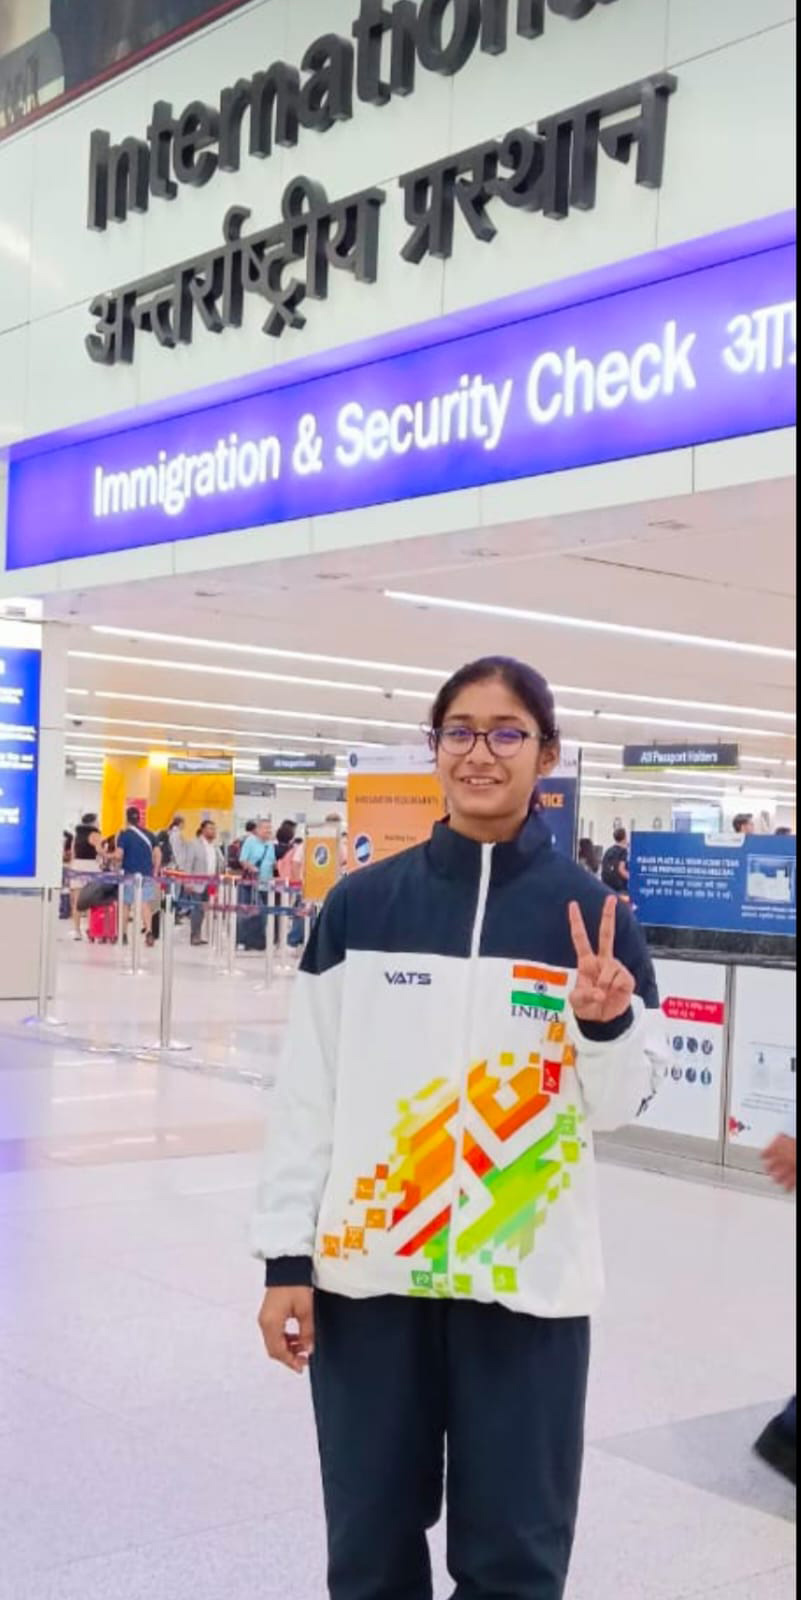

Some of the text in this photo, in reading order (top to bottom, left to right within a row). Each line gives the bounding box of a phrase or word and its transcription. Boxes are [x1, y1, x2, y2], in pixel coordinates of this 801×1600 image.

[86, 0, 617, 232] Internatio
[84, 71, 678, 366] अन्तर्राष्ट्रीय प्रस्थान
[94, 319, 697, 517] Immigration & Security Check
[640, 751, 653, 765] All
[653, 750, 686, 765] Passport
[384, 971, 432, 985] VATS
[511, 1004, 560, 1023] INDIA
